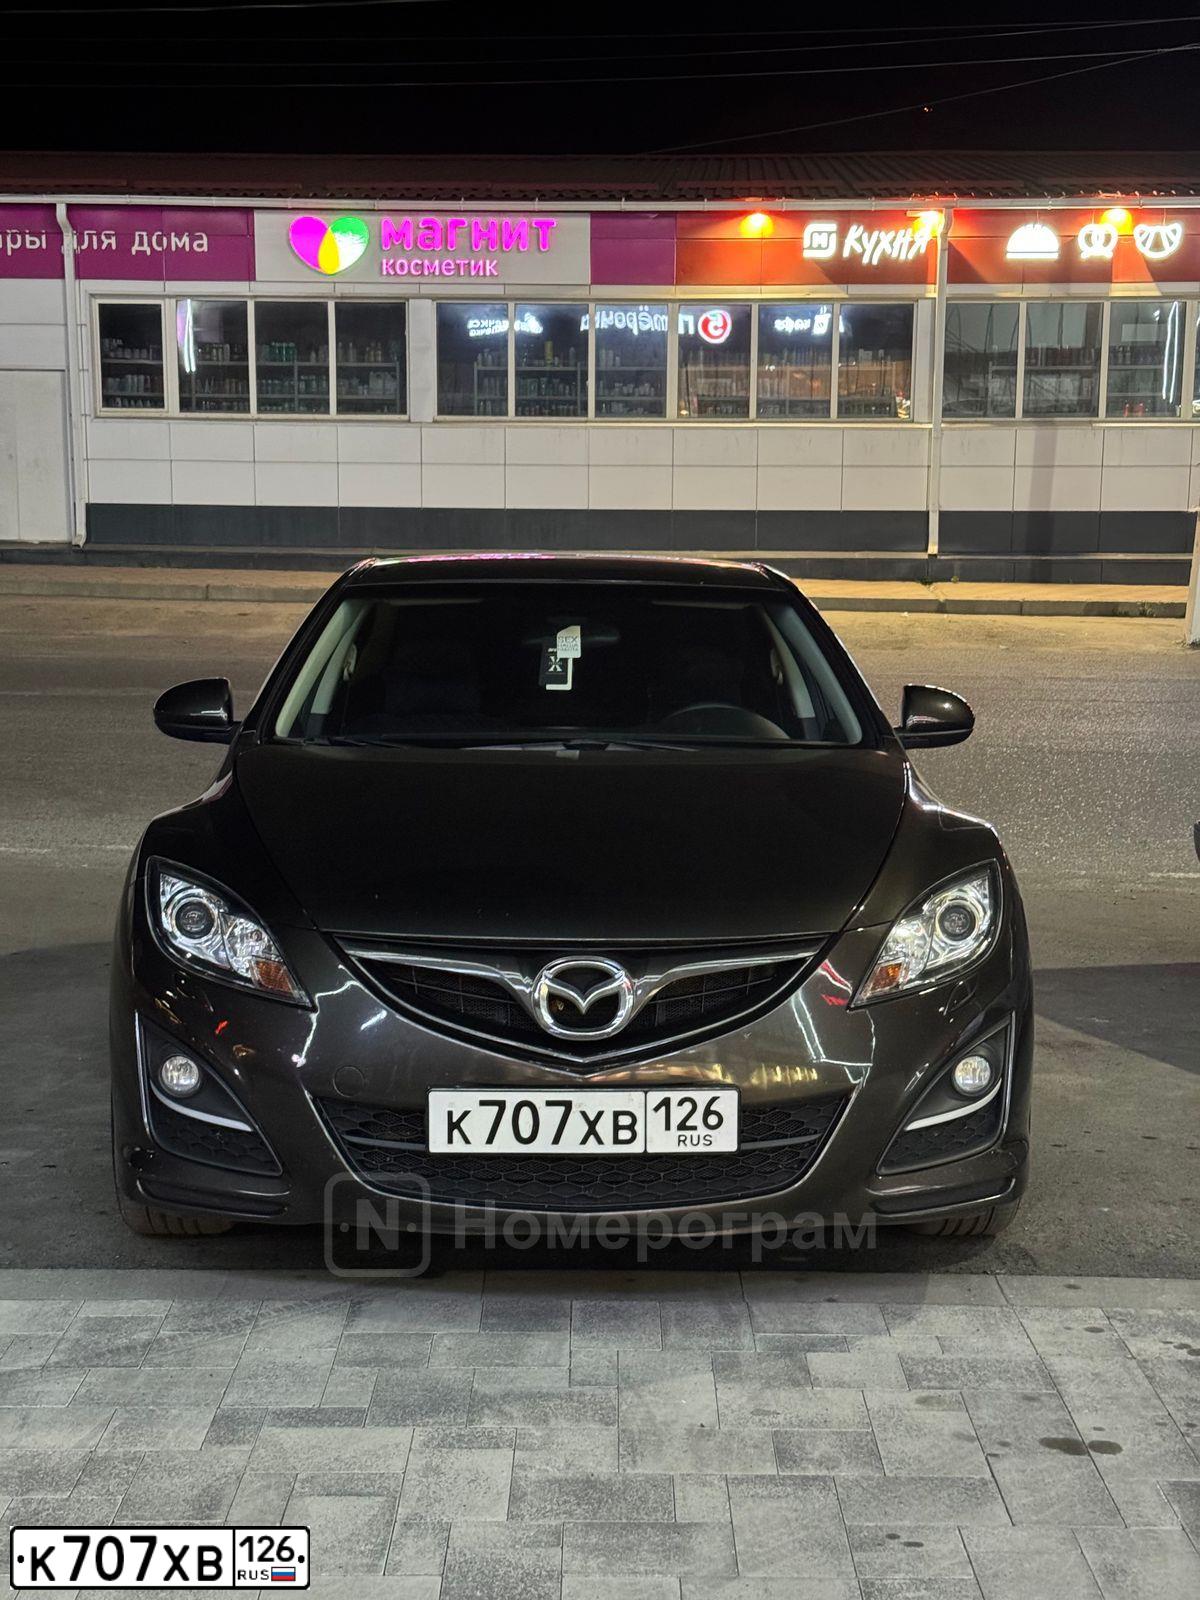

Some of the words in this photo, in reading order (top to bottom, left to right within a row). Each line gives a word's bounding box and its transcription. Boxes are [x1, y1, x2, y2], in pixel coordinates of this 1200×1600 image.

[0, 229, 47, 256] ры
[131, 231, 209, 256] дома
[381, 258, 499, 277] косметик
[447, 1099, 637, 1146] К707ХВ
[653, 1096, 724, 1131] 126
[677, 1133, 713, 1147] RUS
